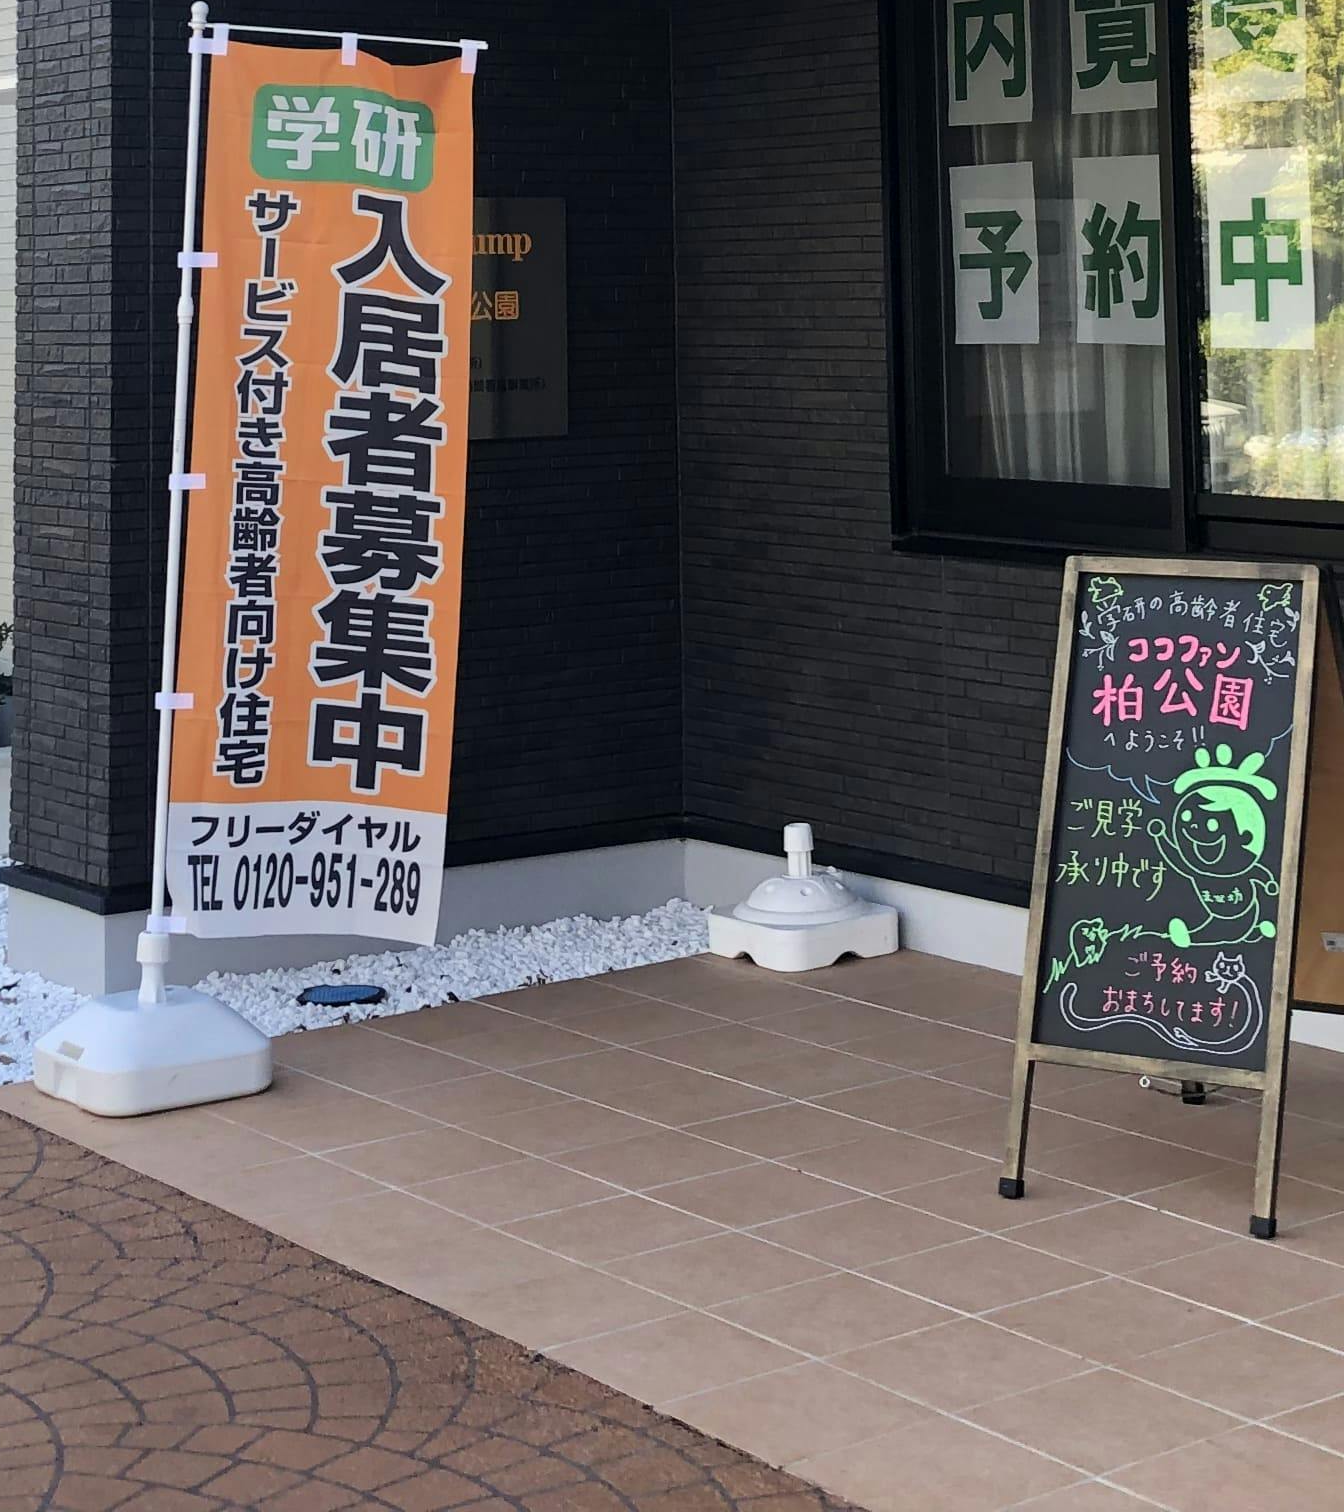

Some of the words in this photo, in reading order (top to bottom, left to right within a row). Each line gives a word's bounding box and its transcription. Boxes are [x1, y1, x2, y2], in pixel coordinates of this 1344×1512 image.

[266, 95, 422, 181] 学研
[473, 232, 532, 261] ump
[471, 291, 519, 321] 公園
[215, 190, 299, 786] サービス付き高齢者向け住宅
[307, 191, 452, 794] 入居者募集中
[1097, 591, 1291, 648] 学研の高齢者住宅
[1127, 635, 1241, 670] ココファン
[1092, 668, 1255, 730] 柏公園
[191, 810, 420, 853] フリーダイヤル
[1067, 799, 1143, 839] ご見学
[188, 855, 223, 911] TEL
[234, 852, 421, 916] 0120-951-289
[1056, 850, 1166, 902] 承り中です
[1125, 953, 1198, 983] ご予約
